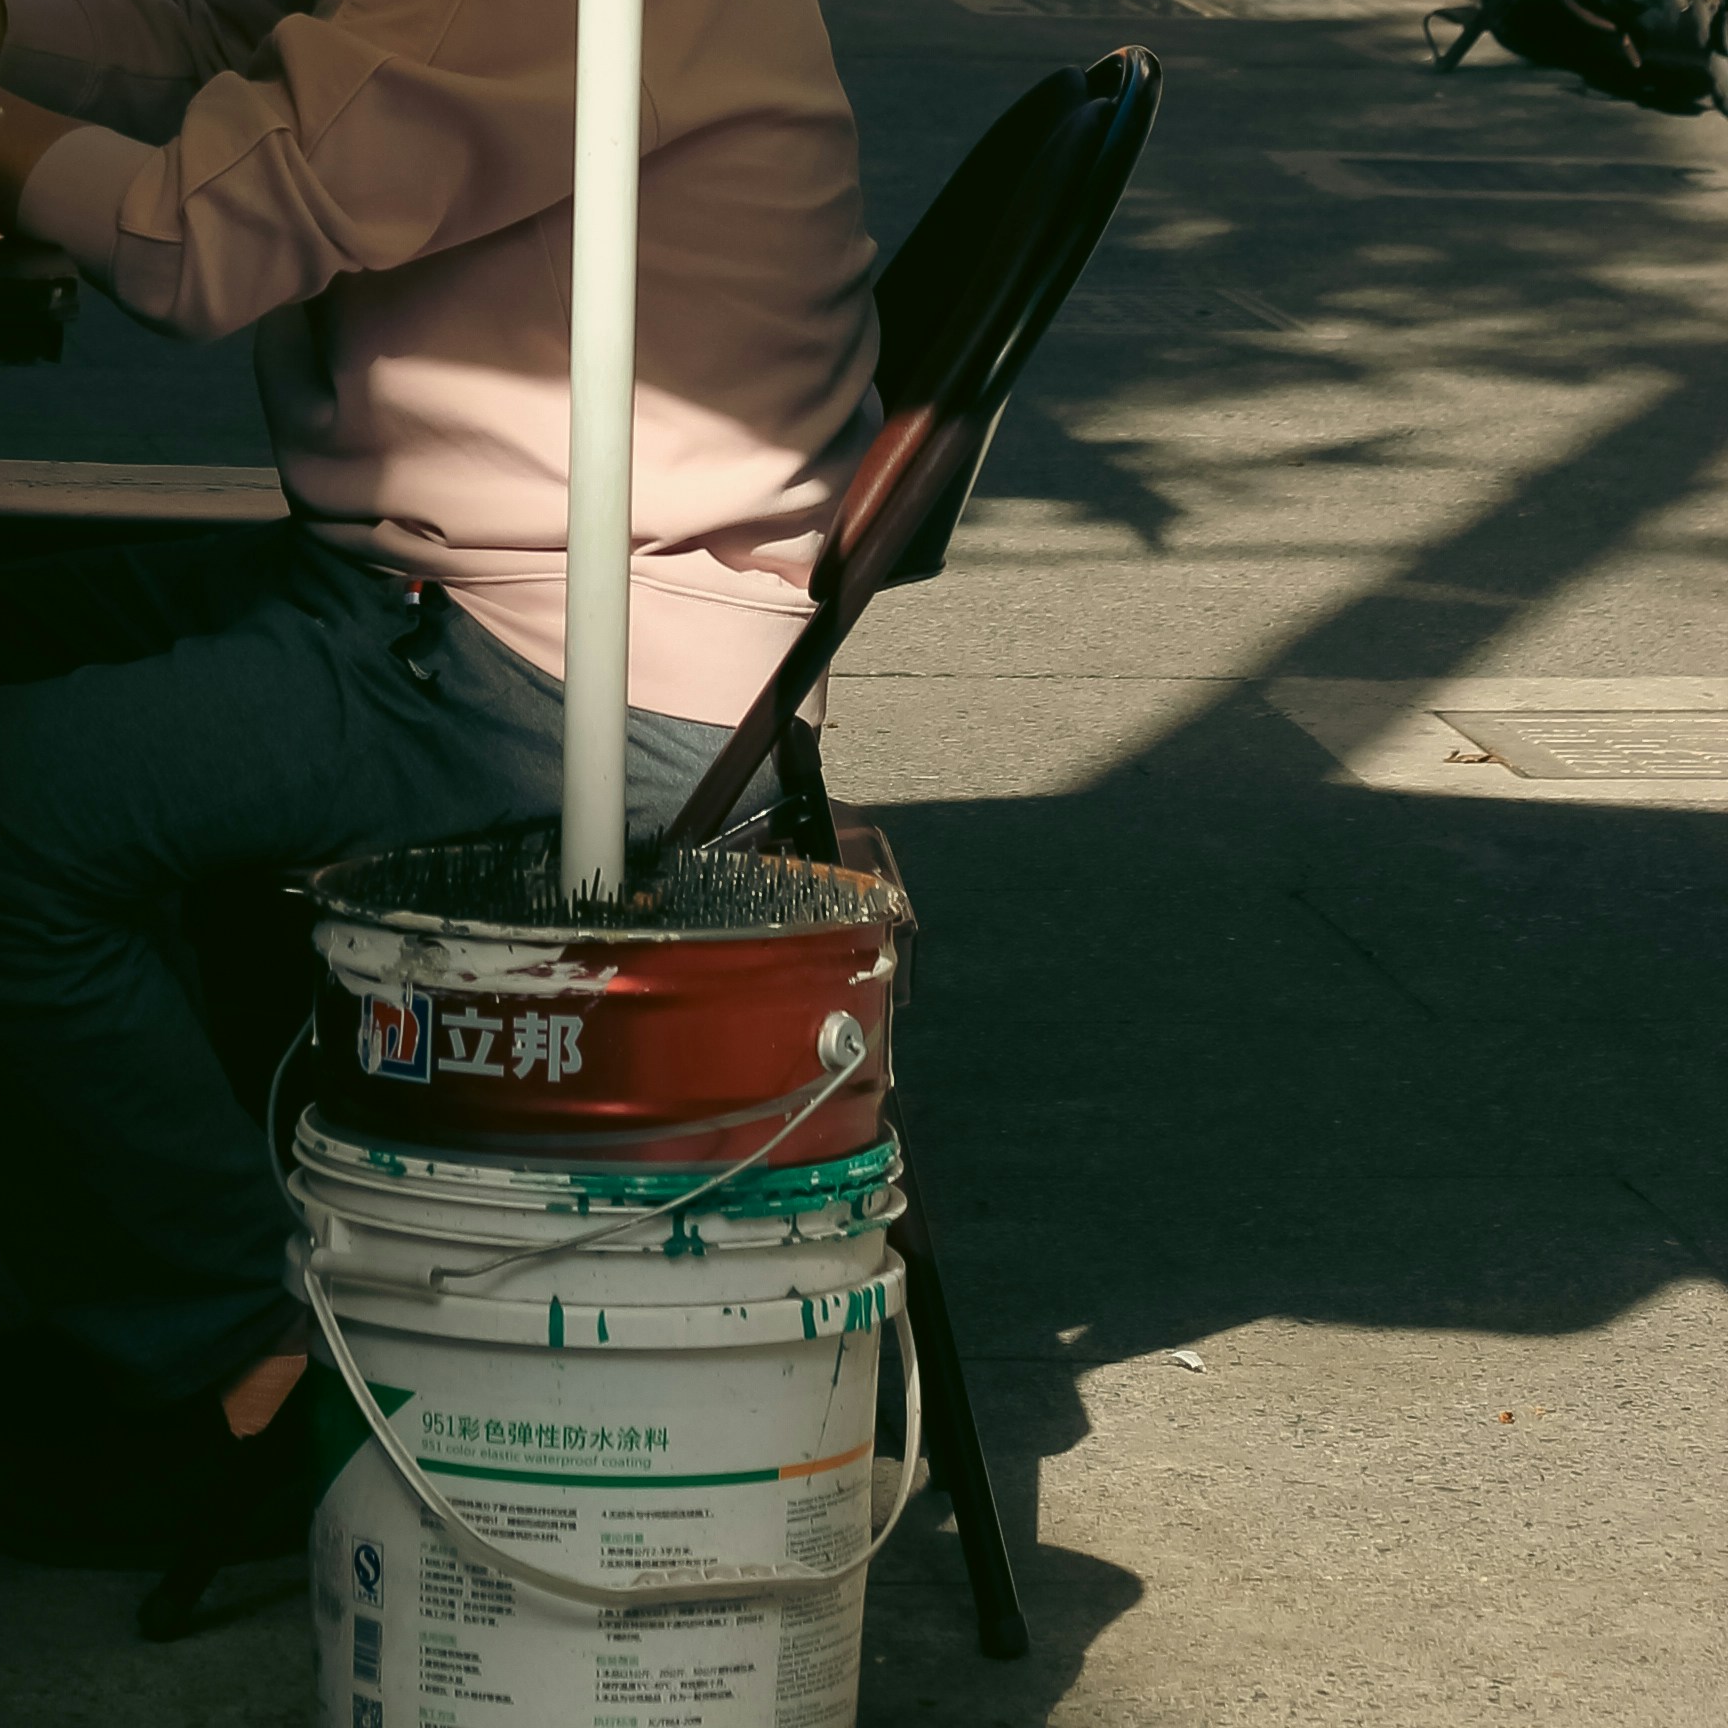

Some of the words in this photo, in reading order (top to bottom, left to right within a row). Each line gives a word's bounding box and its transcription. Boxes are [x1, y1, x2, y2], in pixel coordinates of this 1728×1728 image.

[439, 1007, 584, 1083] 立邦
[423, 1410, 669, 1453] 951彩色弹性防水涂料
[523, 1452, 598, 1469] waterproof
[602, 1454, 651, 1470] coating
